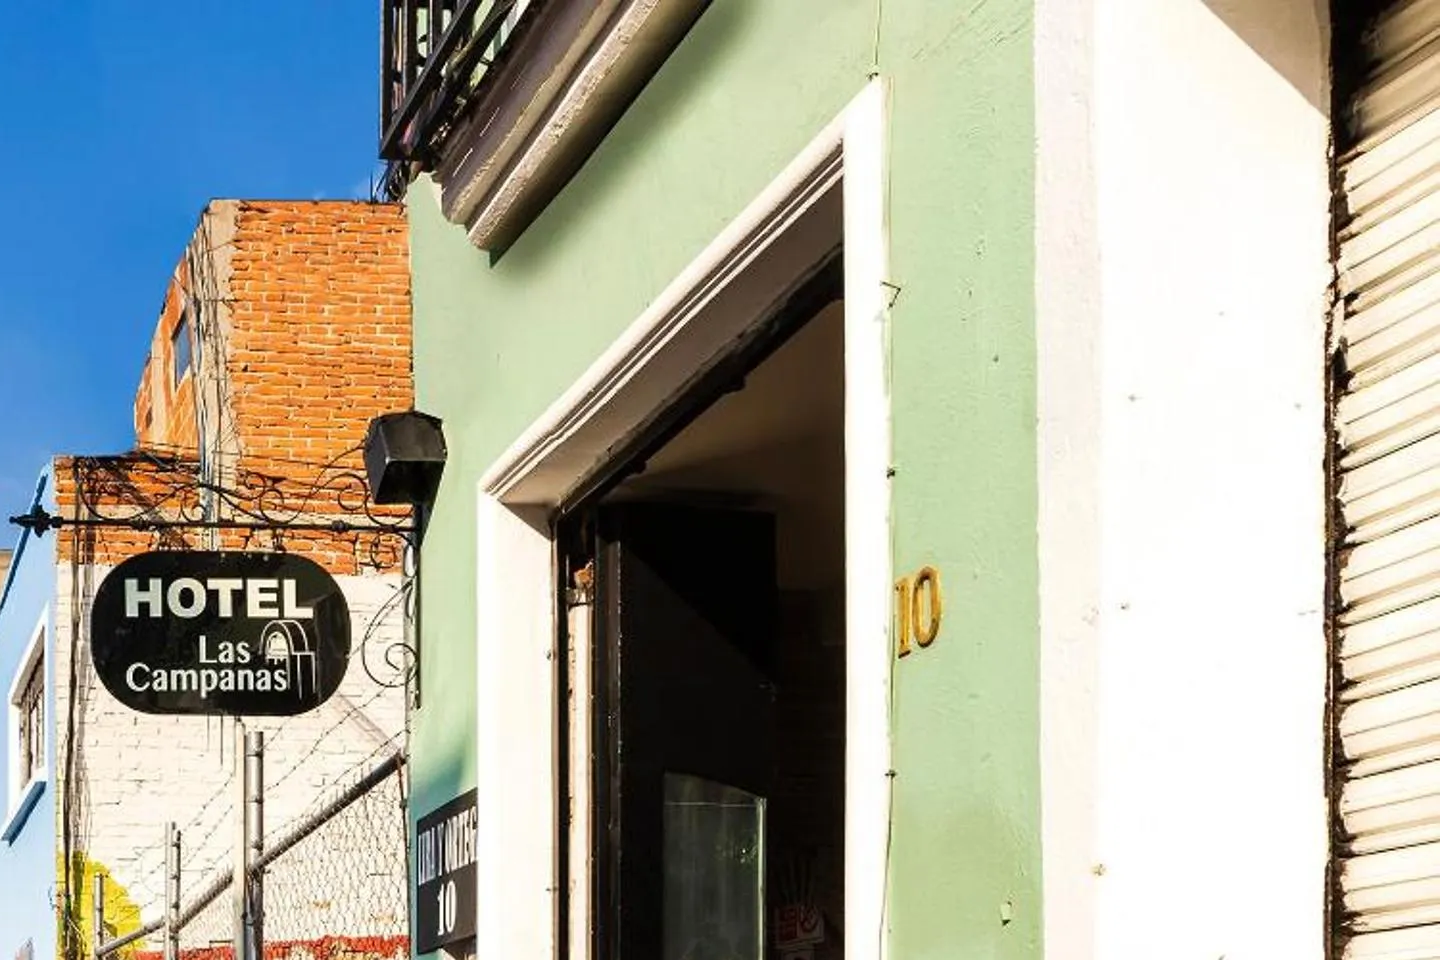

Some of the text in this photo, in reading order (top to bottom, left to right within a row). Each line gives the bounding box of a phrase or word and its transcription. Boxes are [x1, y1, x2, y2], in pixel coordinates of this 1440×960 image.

[124, 577, 314, 618] HOTEL
[895, 565, 941, 659] 10
[198, 635, 251, 664] Las
[125, 662, 288, 698] Campanas
[437, 880, 457, 937] 10
